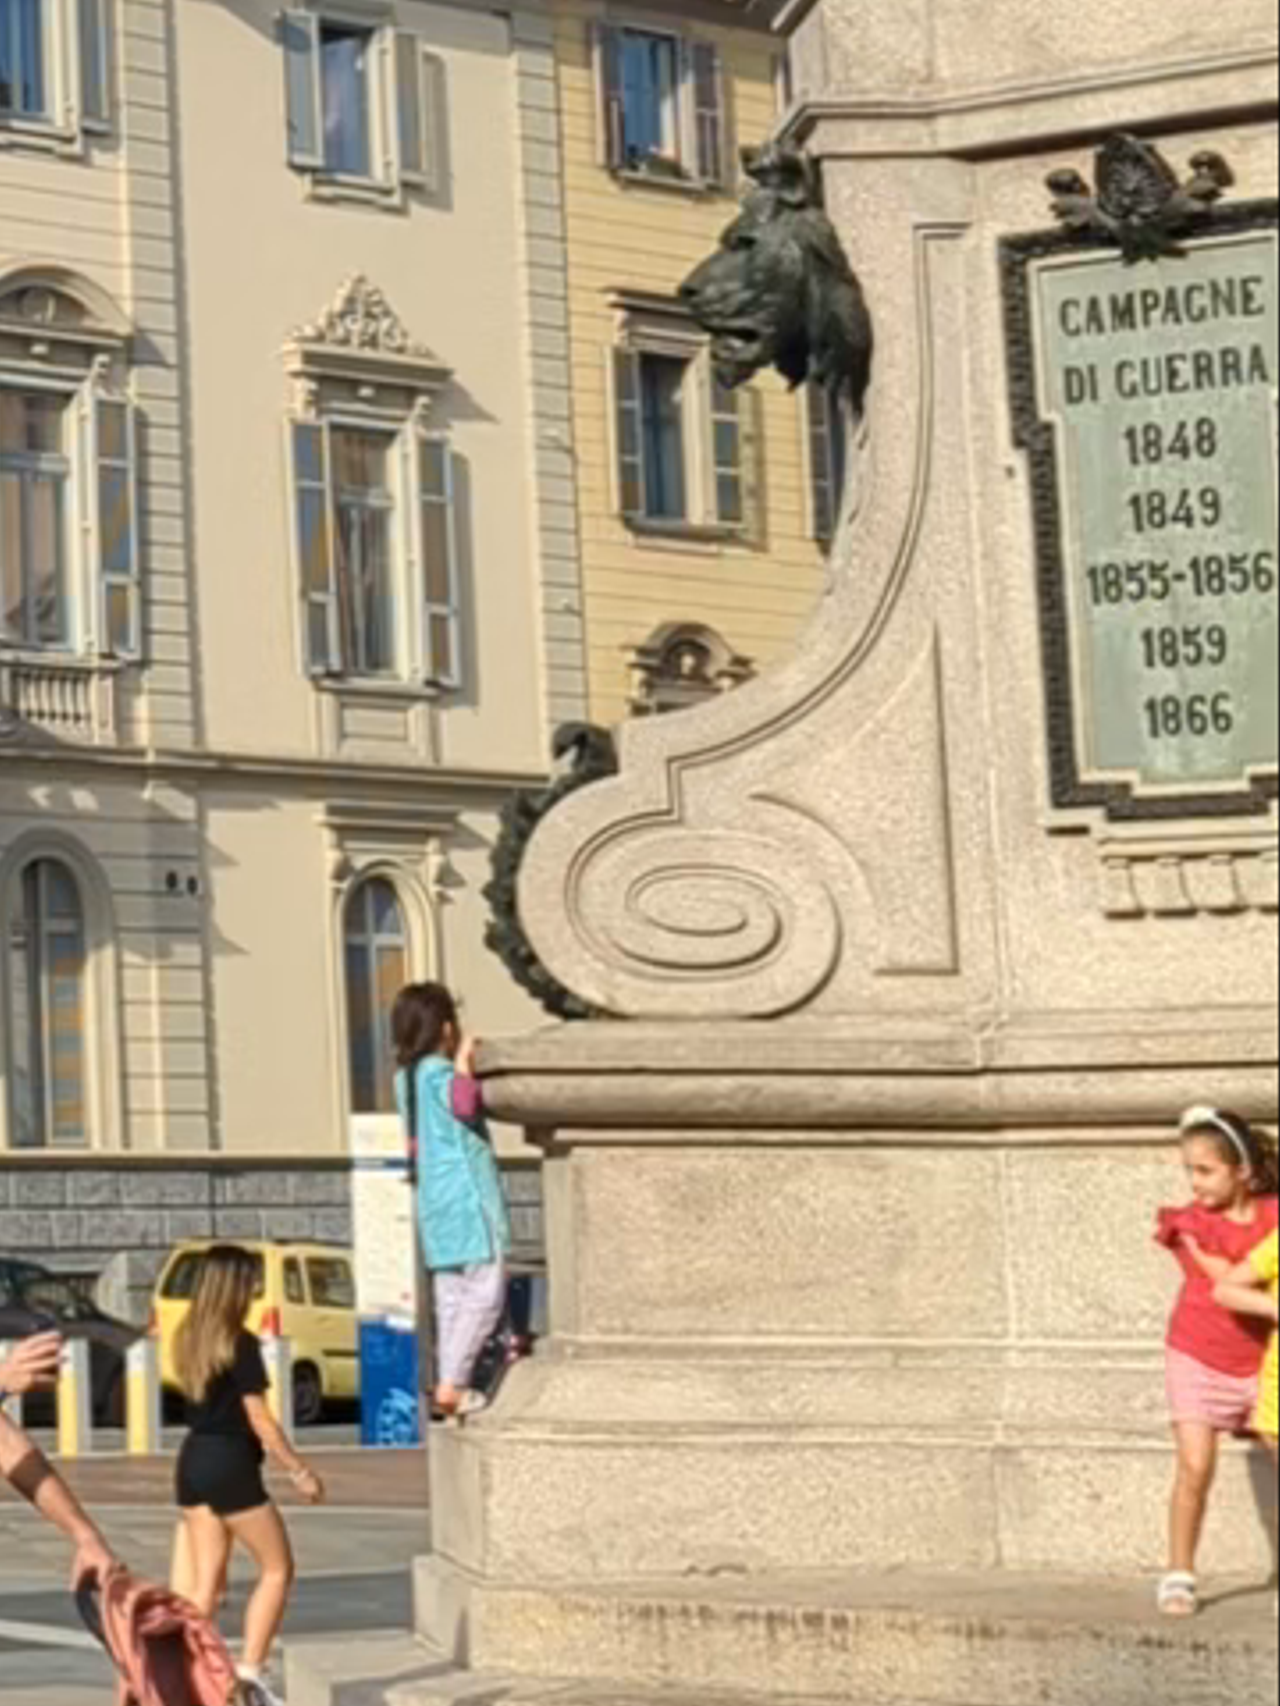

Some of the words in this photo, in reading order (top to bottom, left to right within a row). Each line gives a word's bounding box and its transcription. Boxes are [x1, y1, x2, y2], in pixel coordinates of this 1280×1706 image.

[1058, 275, 1265, 337] CAMPAGNE
[1063, 364, 1099, 405] DI
[1114, 343, 1269, 400] GUERRA
[1124, 417, 1217, 466] 1848
[1127, 486, 1221, 533] 1849
[1086, 551, 1275, 606] 1855-1856
[1141, 624, 1227, 668] 1859
[1143, 691, 1234, 739] 1866
